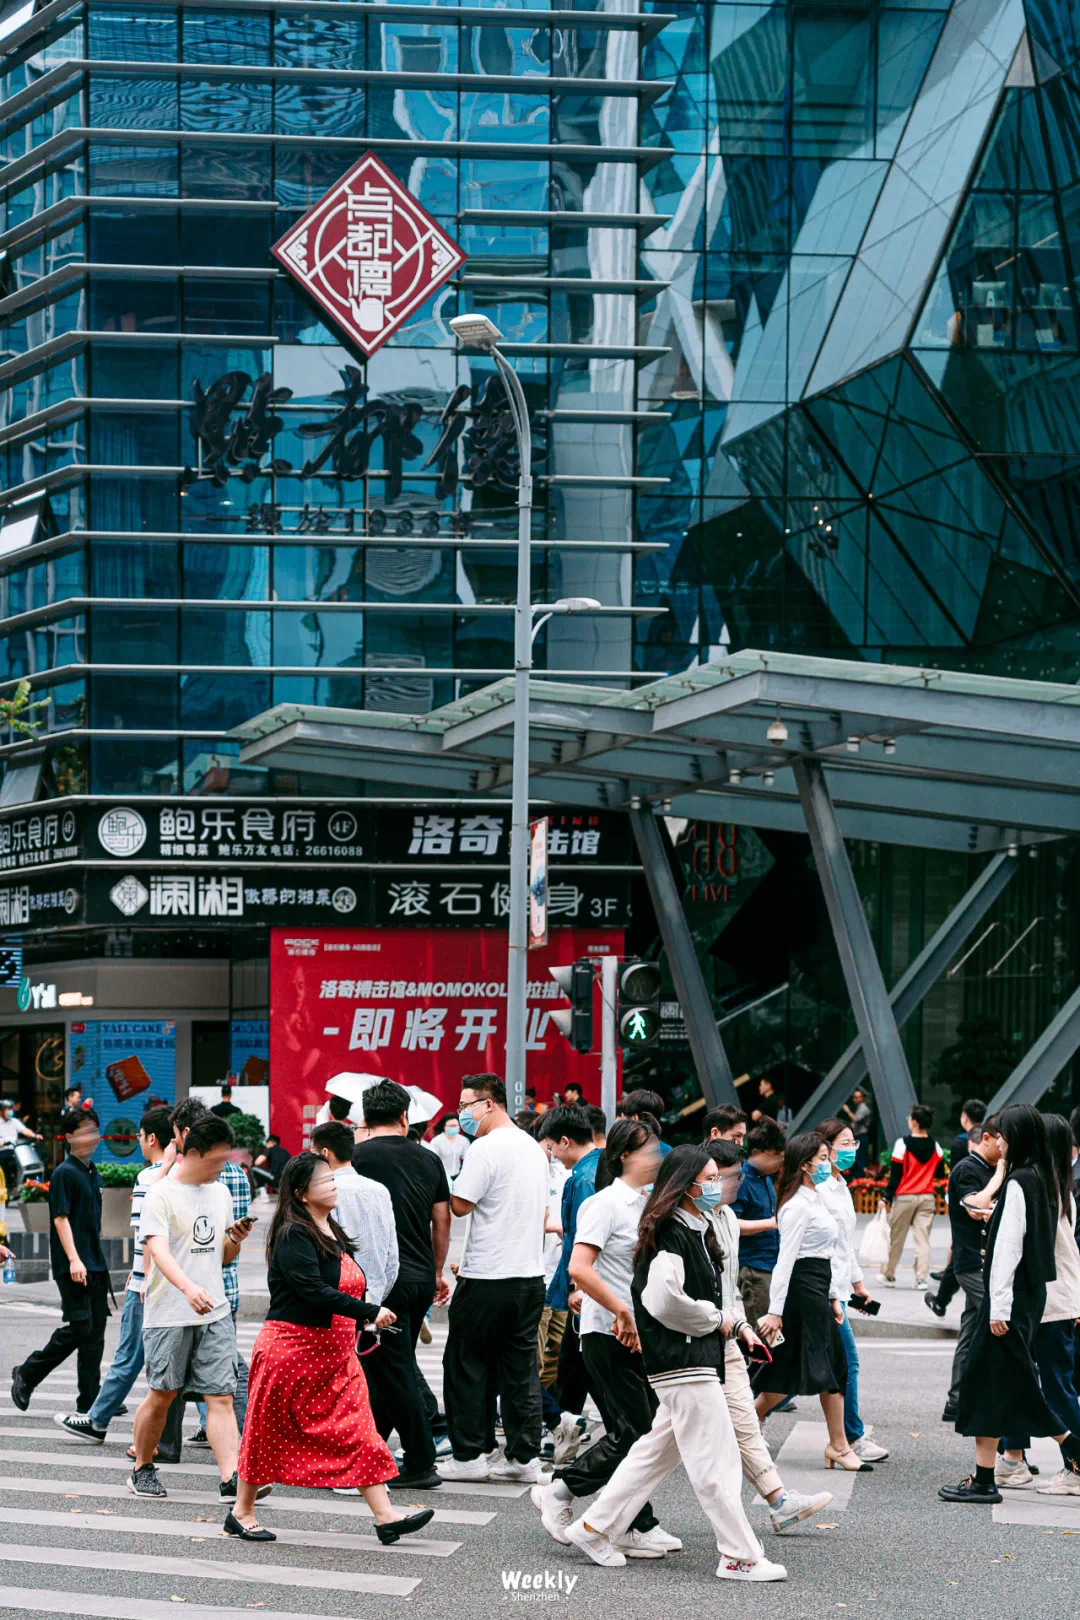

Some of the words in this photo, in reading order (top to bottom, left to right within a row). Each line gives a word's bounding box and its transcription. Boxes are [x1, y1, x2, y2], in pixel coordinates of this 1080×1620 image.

[159, 807, 317, 842] 鲍乐食府
[331, 820, 353, 834] 4F
[305, 845, 363, 857] 26616088
[590, 898, 618, 917] 3F
